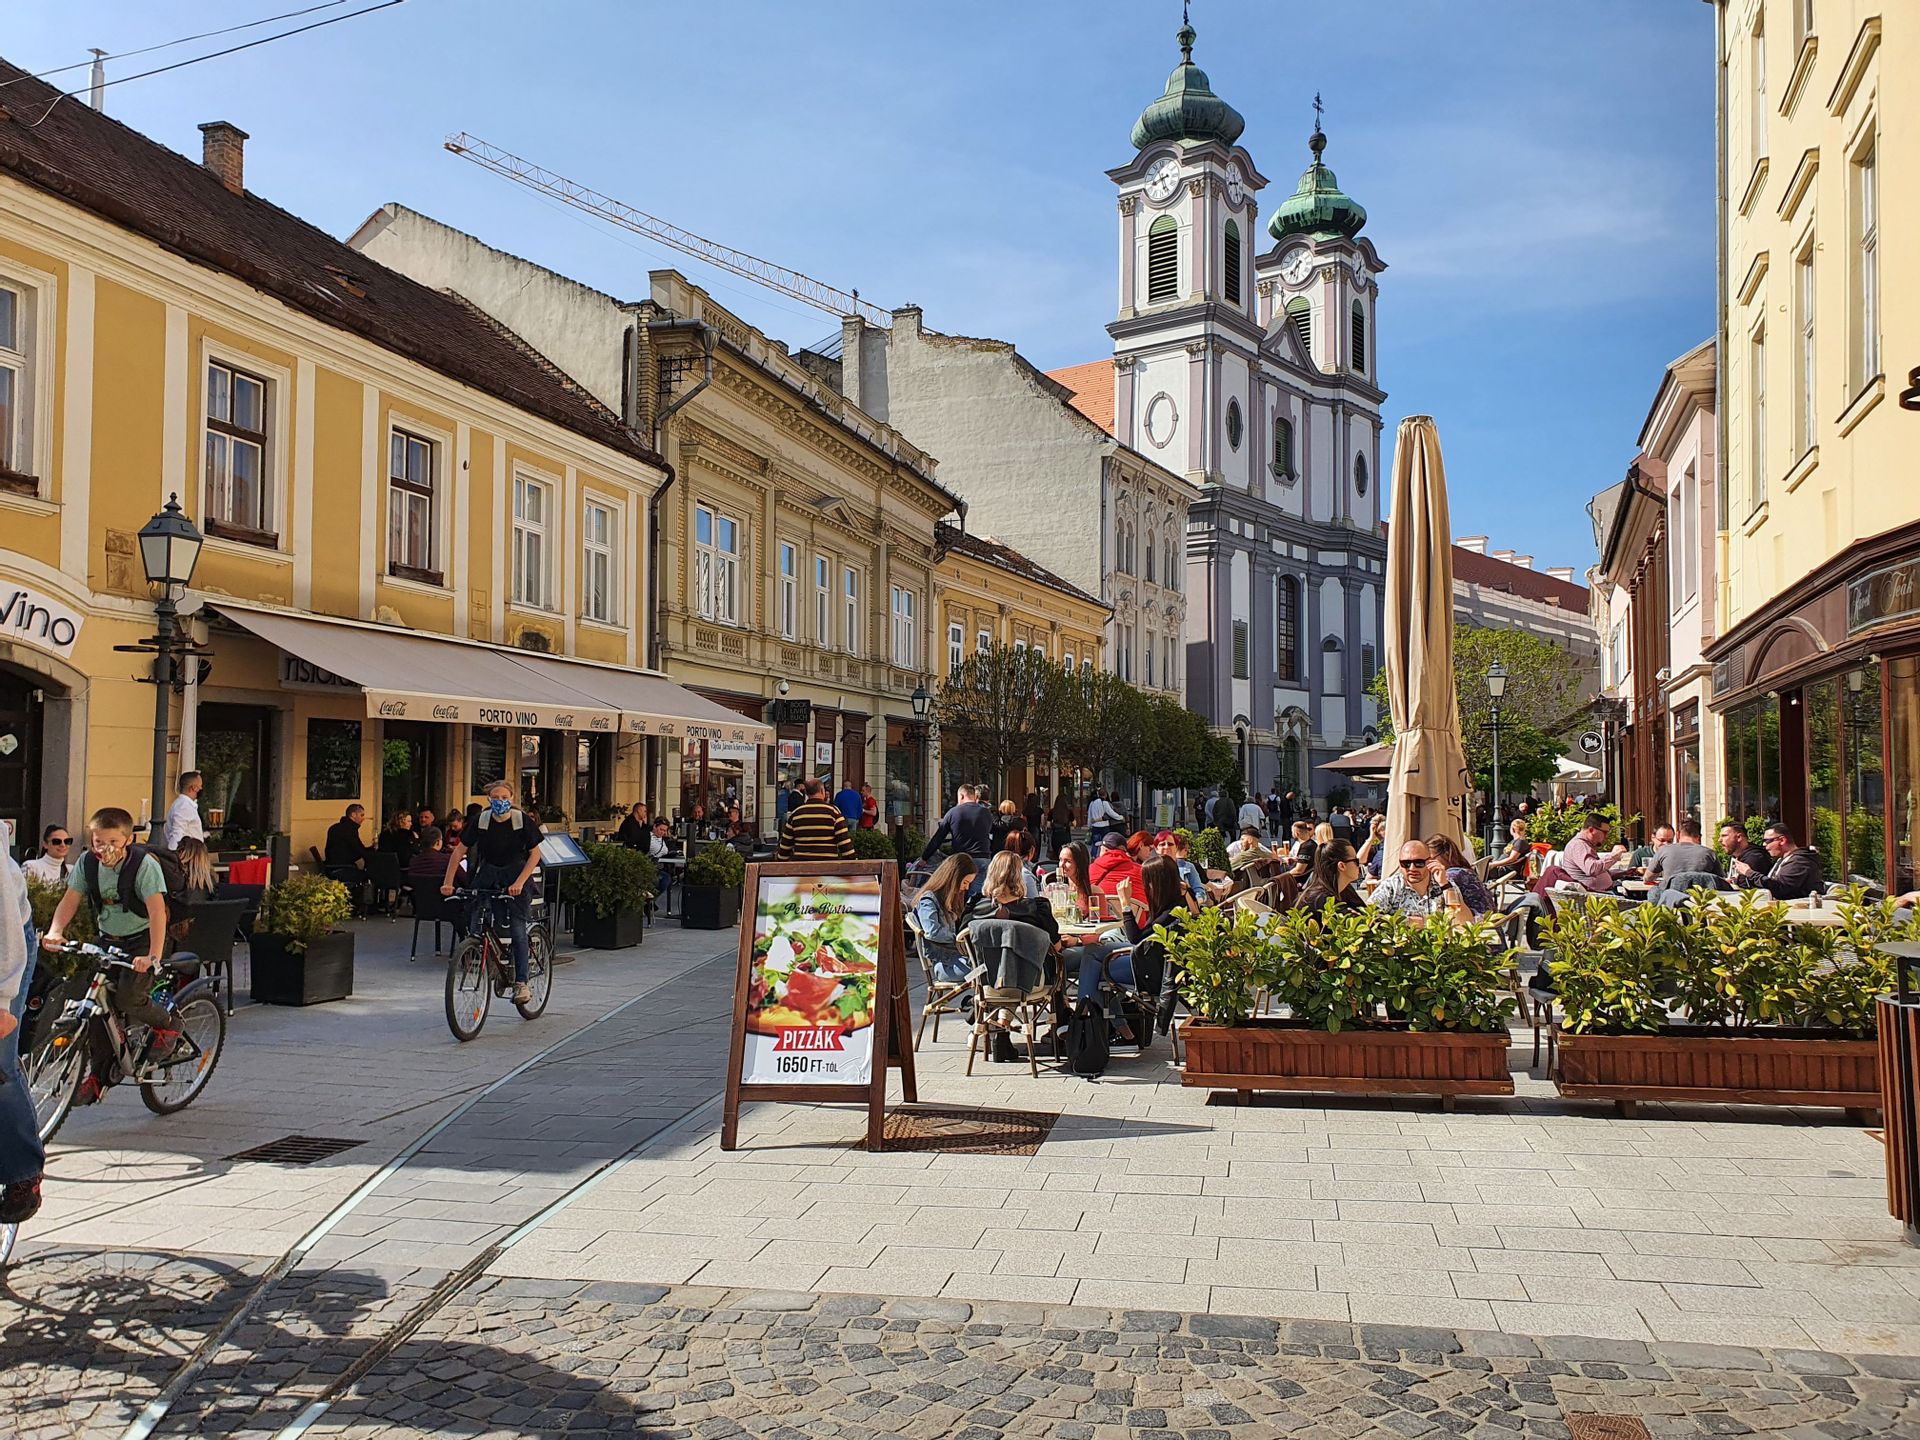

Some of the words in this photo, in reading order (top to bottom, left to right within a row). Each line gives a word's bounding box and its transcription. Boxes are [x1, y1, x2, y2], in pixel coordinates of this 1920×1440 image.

[479, 708, 513, 724] PORTO
[515, 711, 538, 726] VINO
[686, 725, 708, 738] PORTO
[708, 728, 722, 739] VINO
[818, 902, 853, 915] Bistro
[782, 1026, 836, 1049] PIZZÁK
[776, 1056, 808, 1073] 1650
